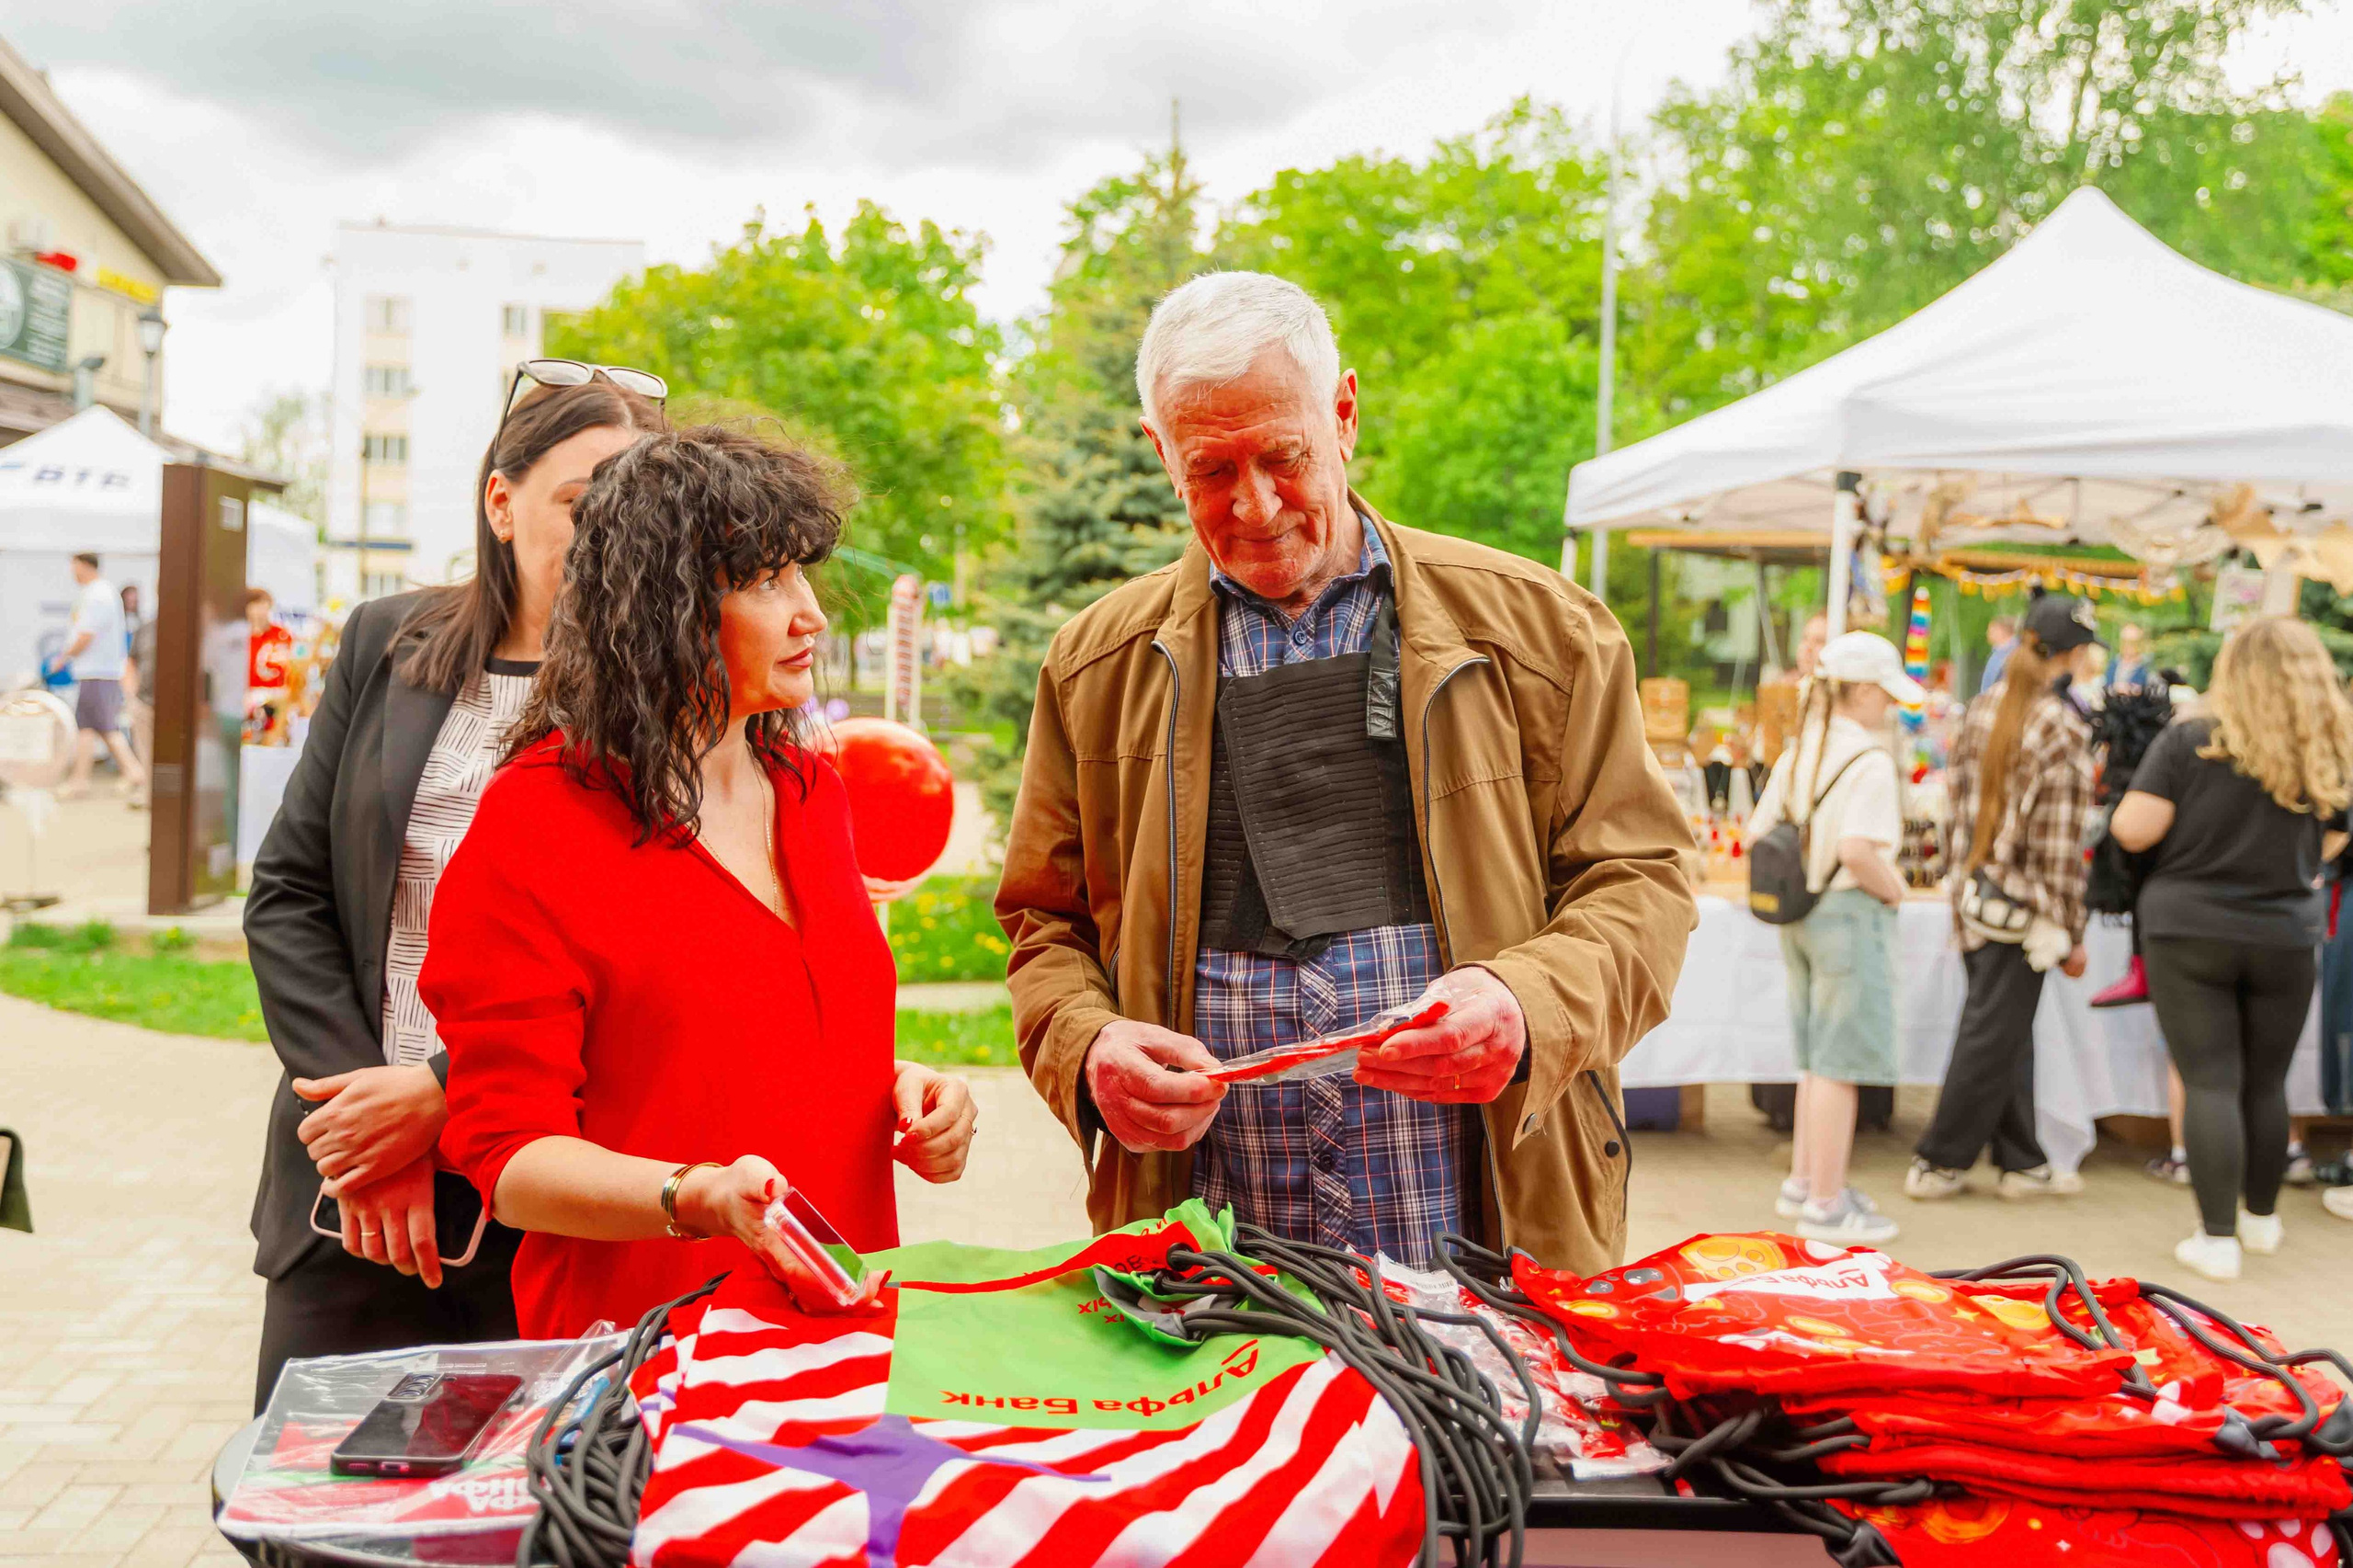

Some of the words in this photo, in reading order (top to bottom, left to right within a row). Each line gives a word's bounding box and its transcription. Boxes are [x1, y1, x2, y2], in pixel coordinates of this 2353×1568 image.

[1781, 1268, 1870, 1289] Альфа
[1094, 1338, 1260, 1417] Альфа
[941, 1390, 1079, 1416] Банк
